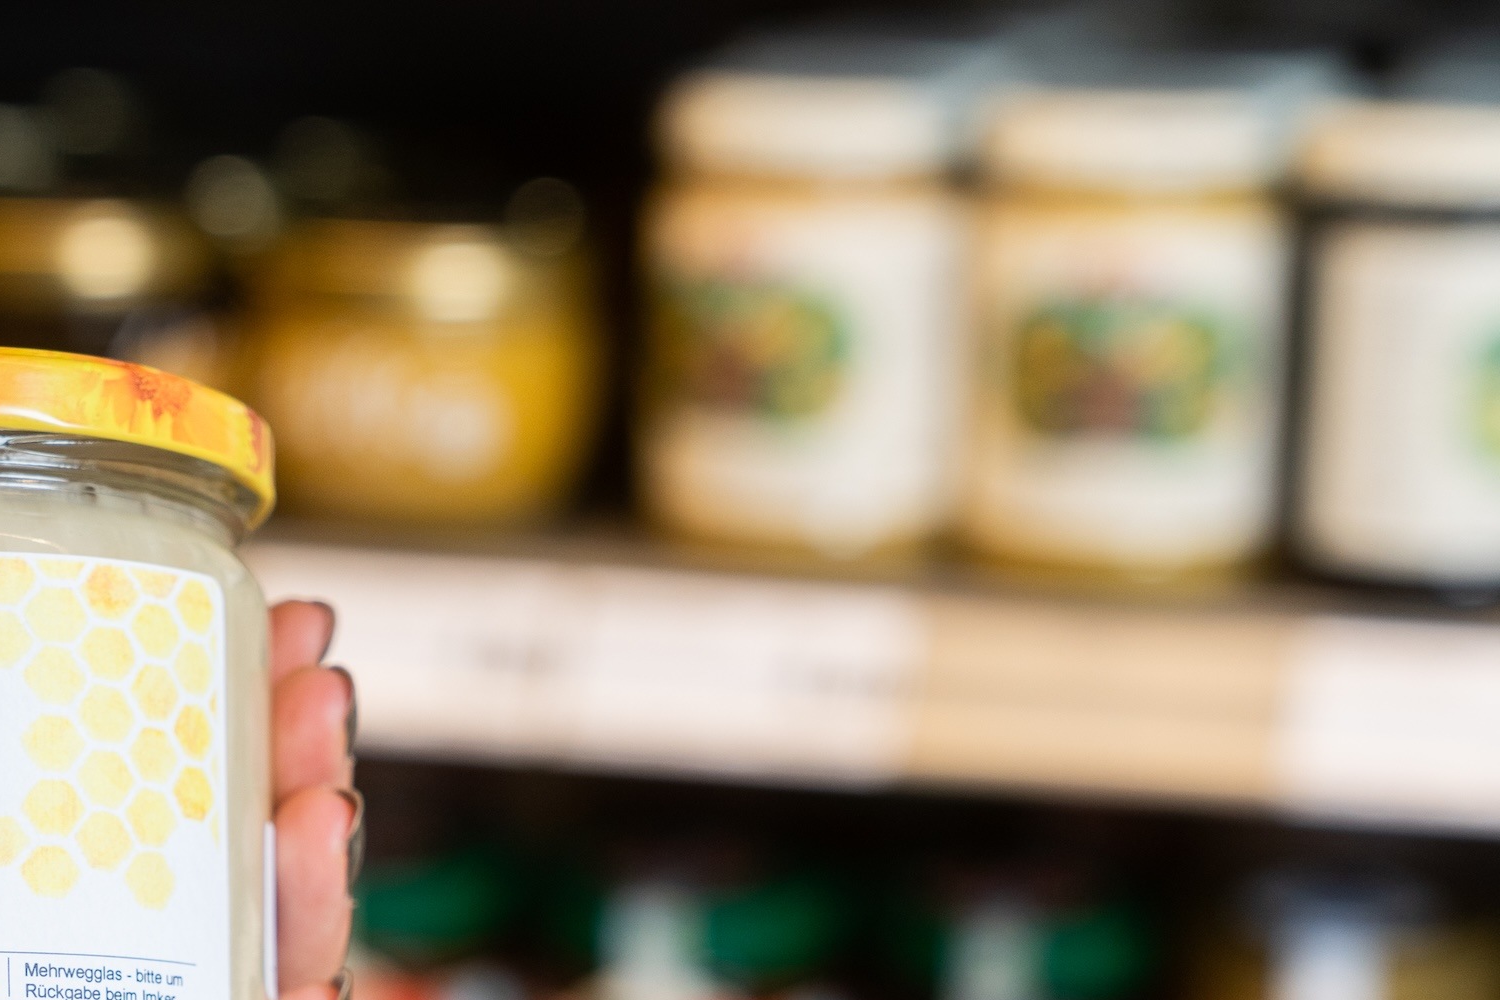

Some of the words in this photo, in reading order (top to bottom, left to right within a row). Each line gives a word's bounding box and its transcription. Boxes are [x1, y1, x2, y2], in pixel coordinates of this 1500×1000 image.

[24, 962, 123, 983] Mehrwegglas
[135, 968, 162, 984] bitte
[166, 973, 184, 987] um
